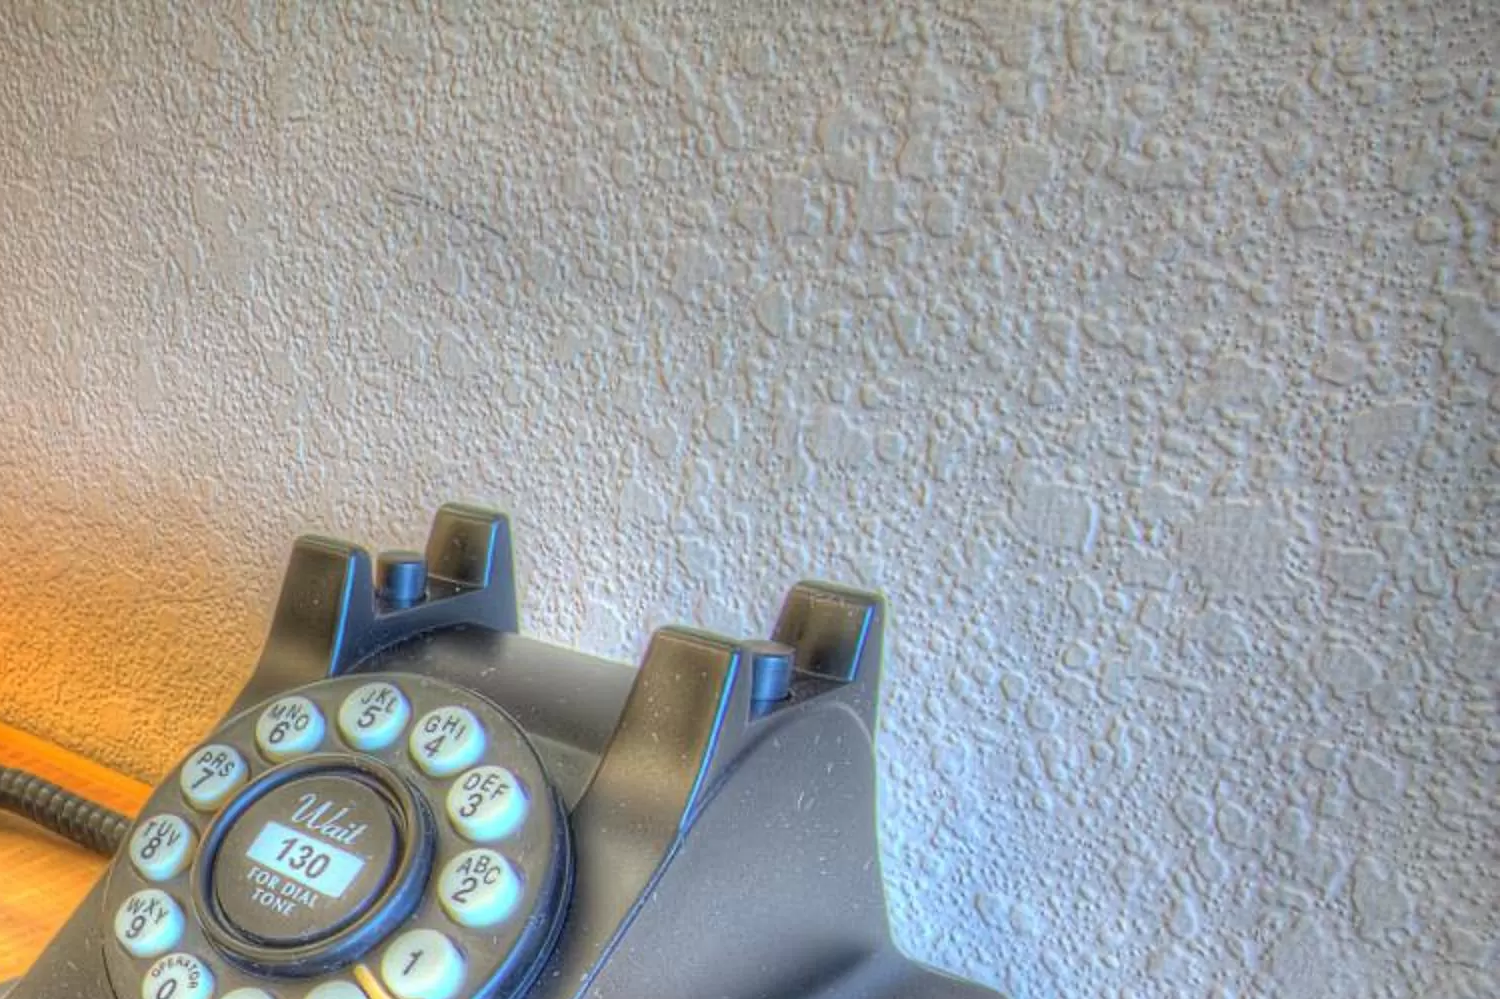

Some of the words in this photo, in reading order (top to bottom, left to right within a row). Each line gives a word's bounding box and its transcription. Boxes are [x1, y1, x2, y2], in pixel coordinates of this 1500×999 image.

[361, 688, 397, 713] JKL
[271, 704, 308, 731] MNO
[358, 706, 381, 728] 5
[425, 716, 466, 741] GHI
[270, 722, 290, 744] 6
[424, 735, 446, 757] 4
[197, 751, 235, 777] PRS
[192, 769, 214, 789] 7
[464, 773, 509, 800] DEF
[292, 793, 368, 844] Wait
[460, 794, 483, 817] 3
[143, 820, 180, 846] TUV
[141, 837, 161, 860] 8
[276, 838, 331, 878] 130
[457, 855, 500, 884] ABC
[247, 867, 280, 890] FOR
[281, 882, 318, 908] DIAL
[452, 877, 477, 903] 2
[127, 898, 169, 924] WXY
[252, 888, 297, 916] TONE
[125, 916, 145, 939] 9
[152, 957, 200, 988] OPERATOR
[403, 950, 423, 976] 1
